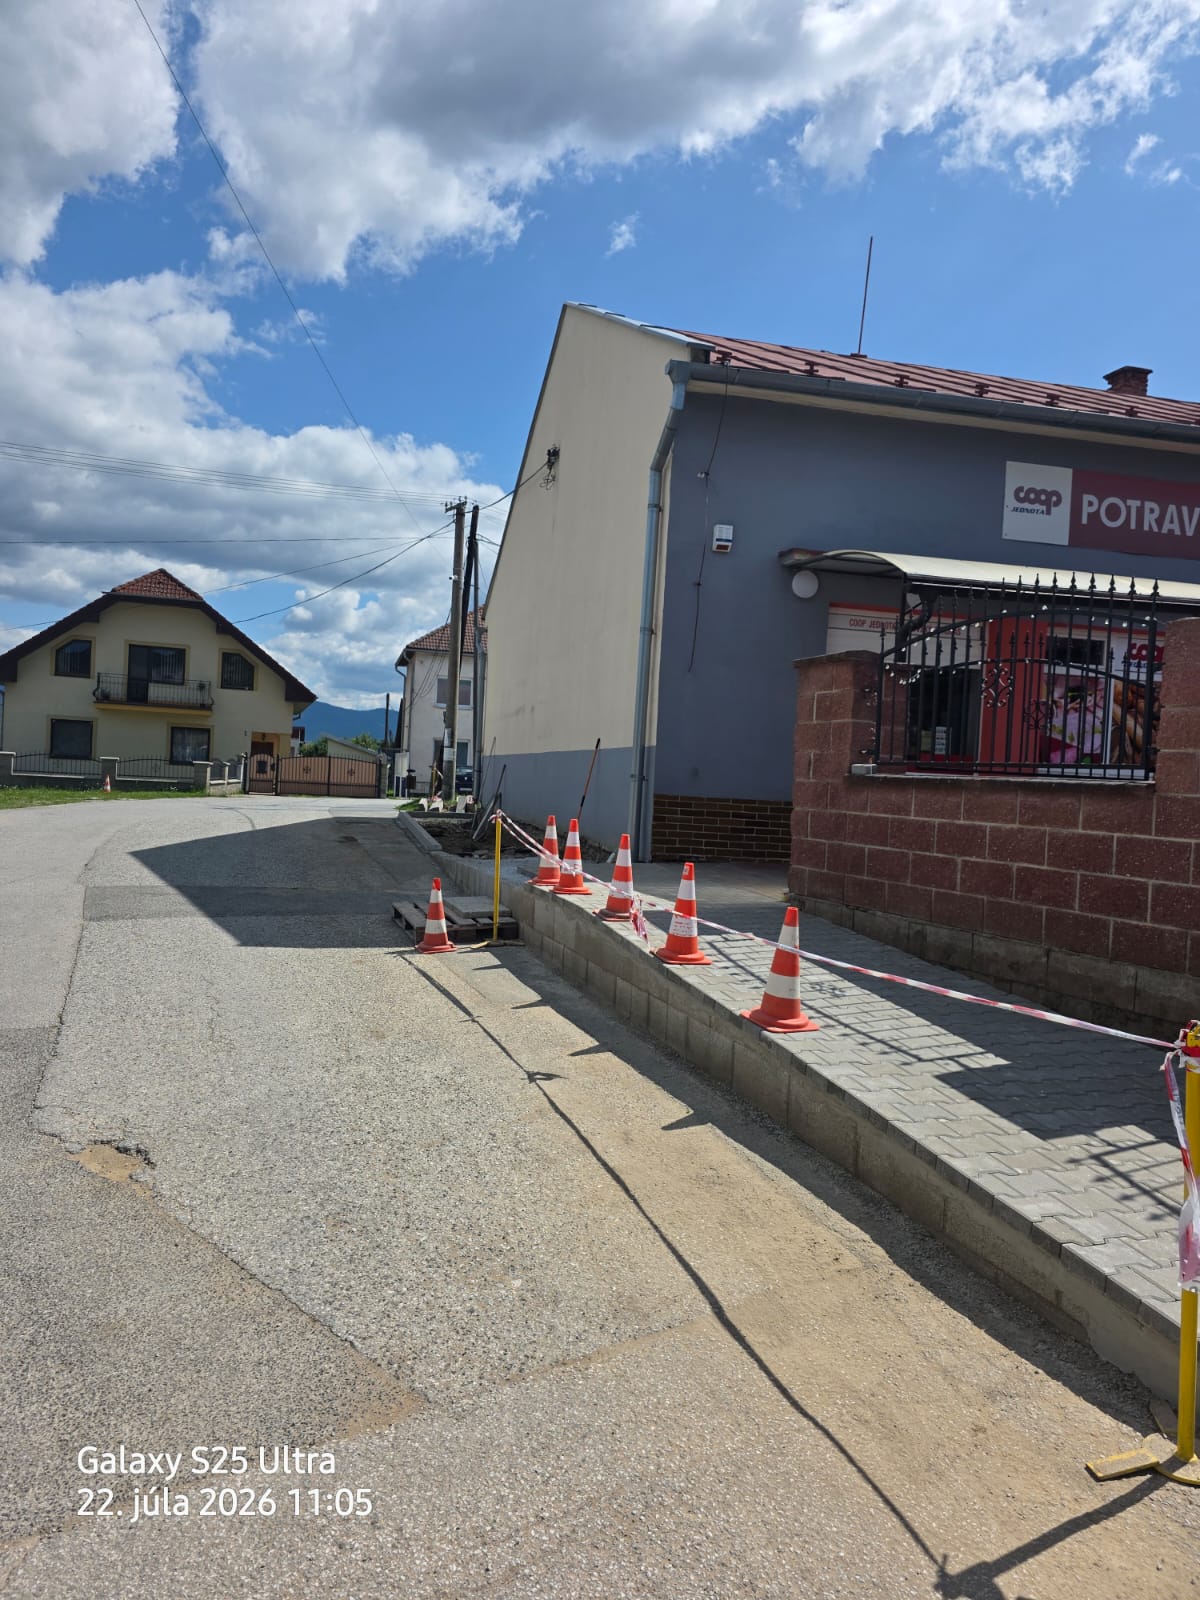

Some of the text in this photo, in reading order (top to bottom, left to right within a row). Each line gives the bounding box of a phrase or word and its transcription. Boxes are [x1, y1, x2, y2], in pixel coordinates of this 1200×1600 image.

[1011, 507, 1045, 516] JEDNOTA
[1081, 493, 1200, 537] POTRAV
[849, 618, 866, 627] COOP
